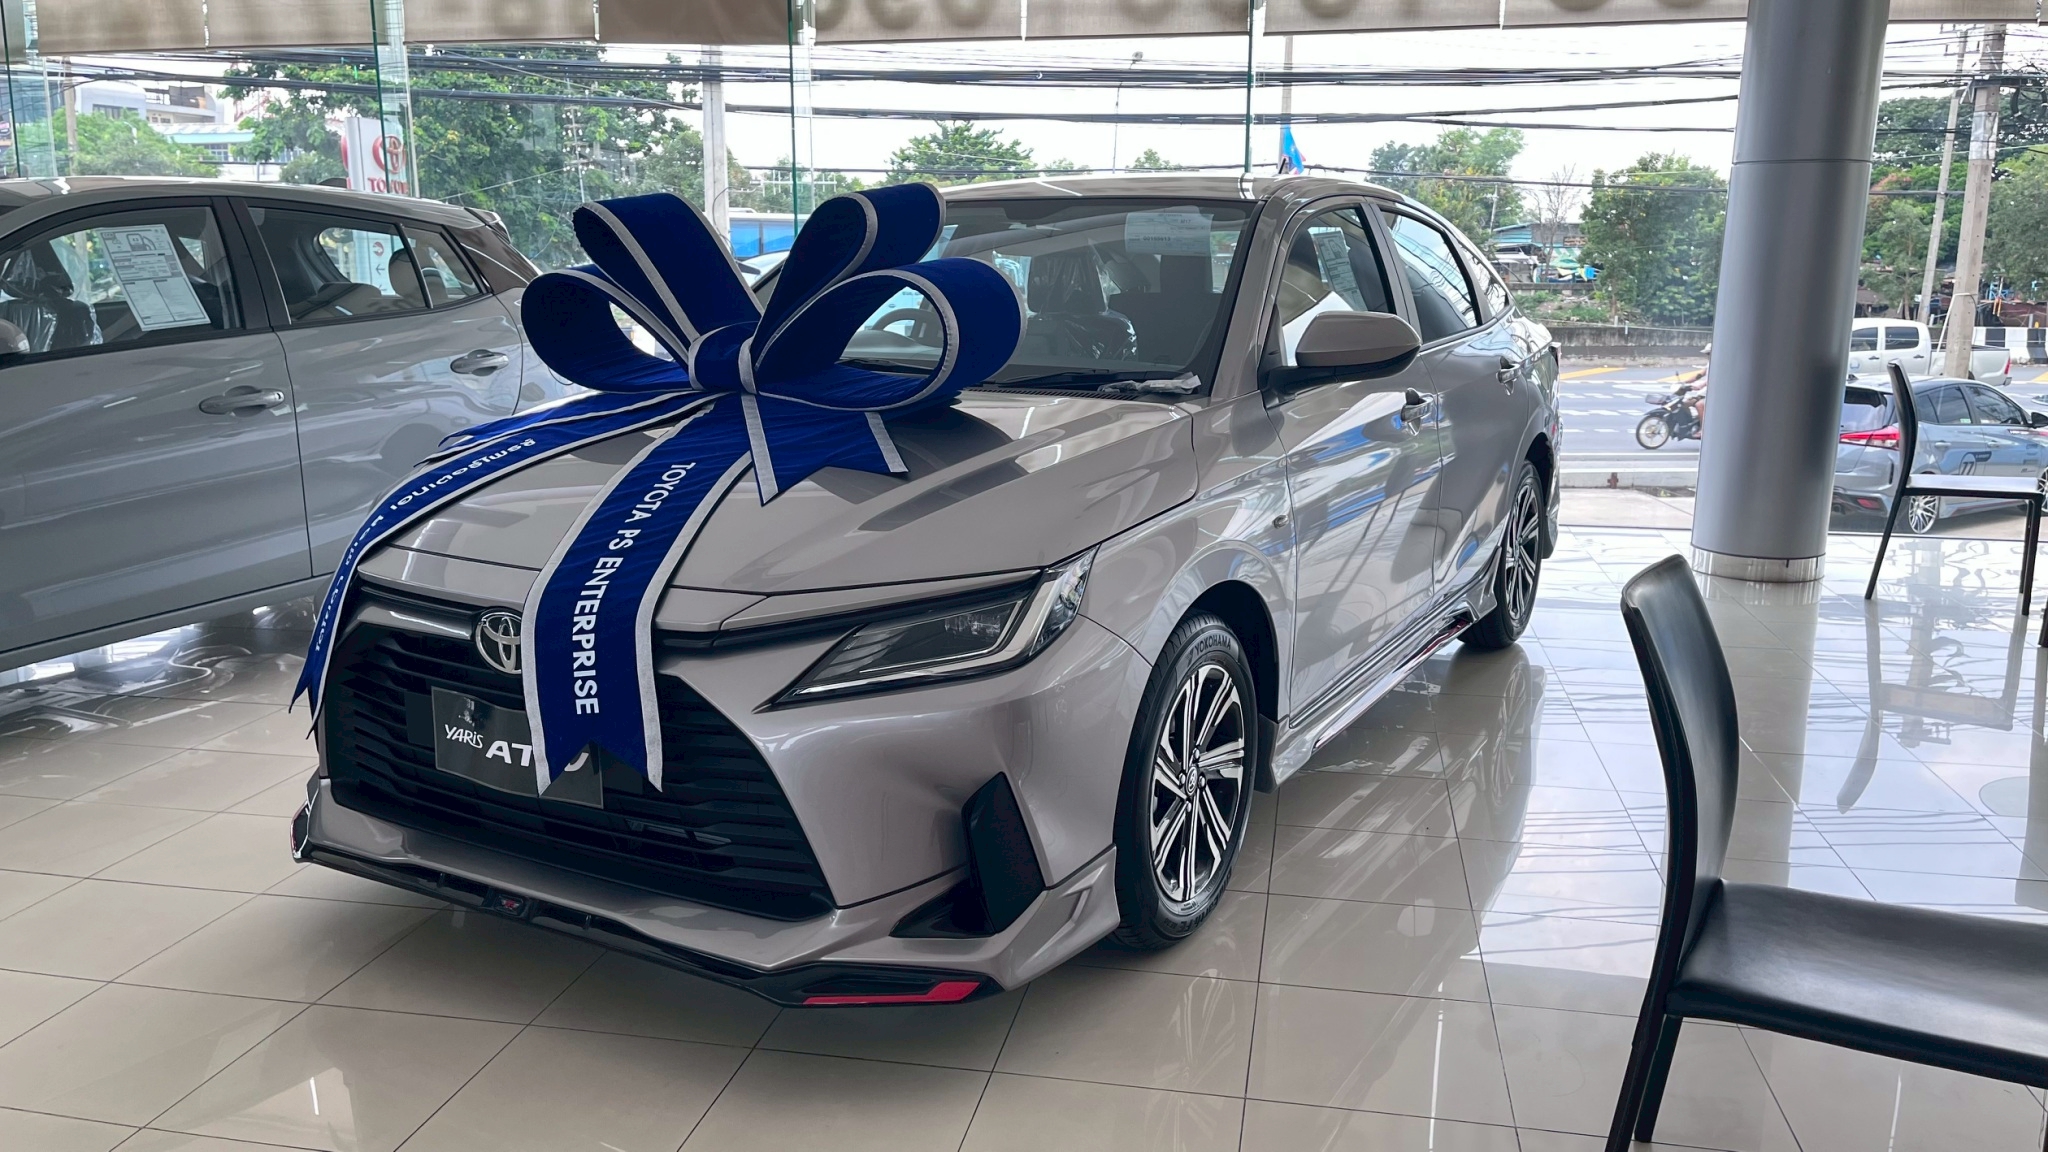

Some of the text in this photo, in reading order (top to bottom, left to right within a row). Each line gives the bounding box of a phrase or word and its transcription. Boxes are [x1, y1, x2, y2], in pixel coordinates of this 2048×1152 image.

[572, 462, 697, 715] TOYOTA PS ENTERPRISE
[1194, 634, 1231, 656] YOKOHAMA
[485, 740, 590, 772] AT
